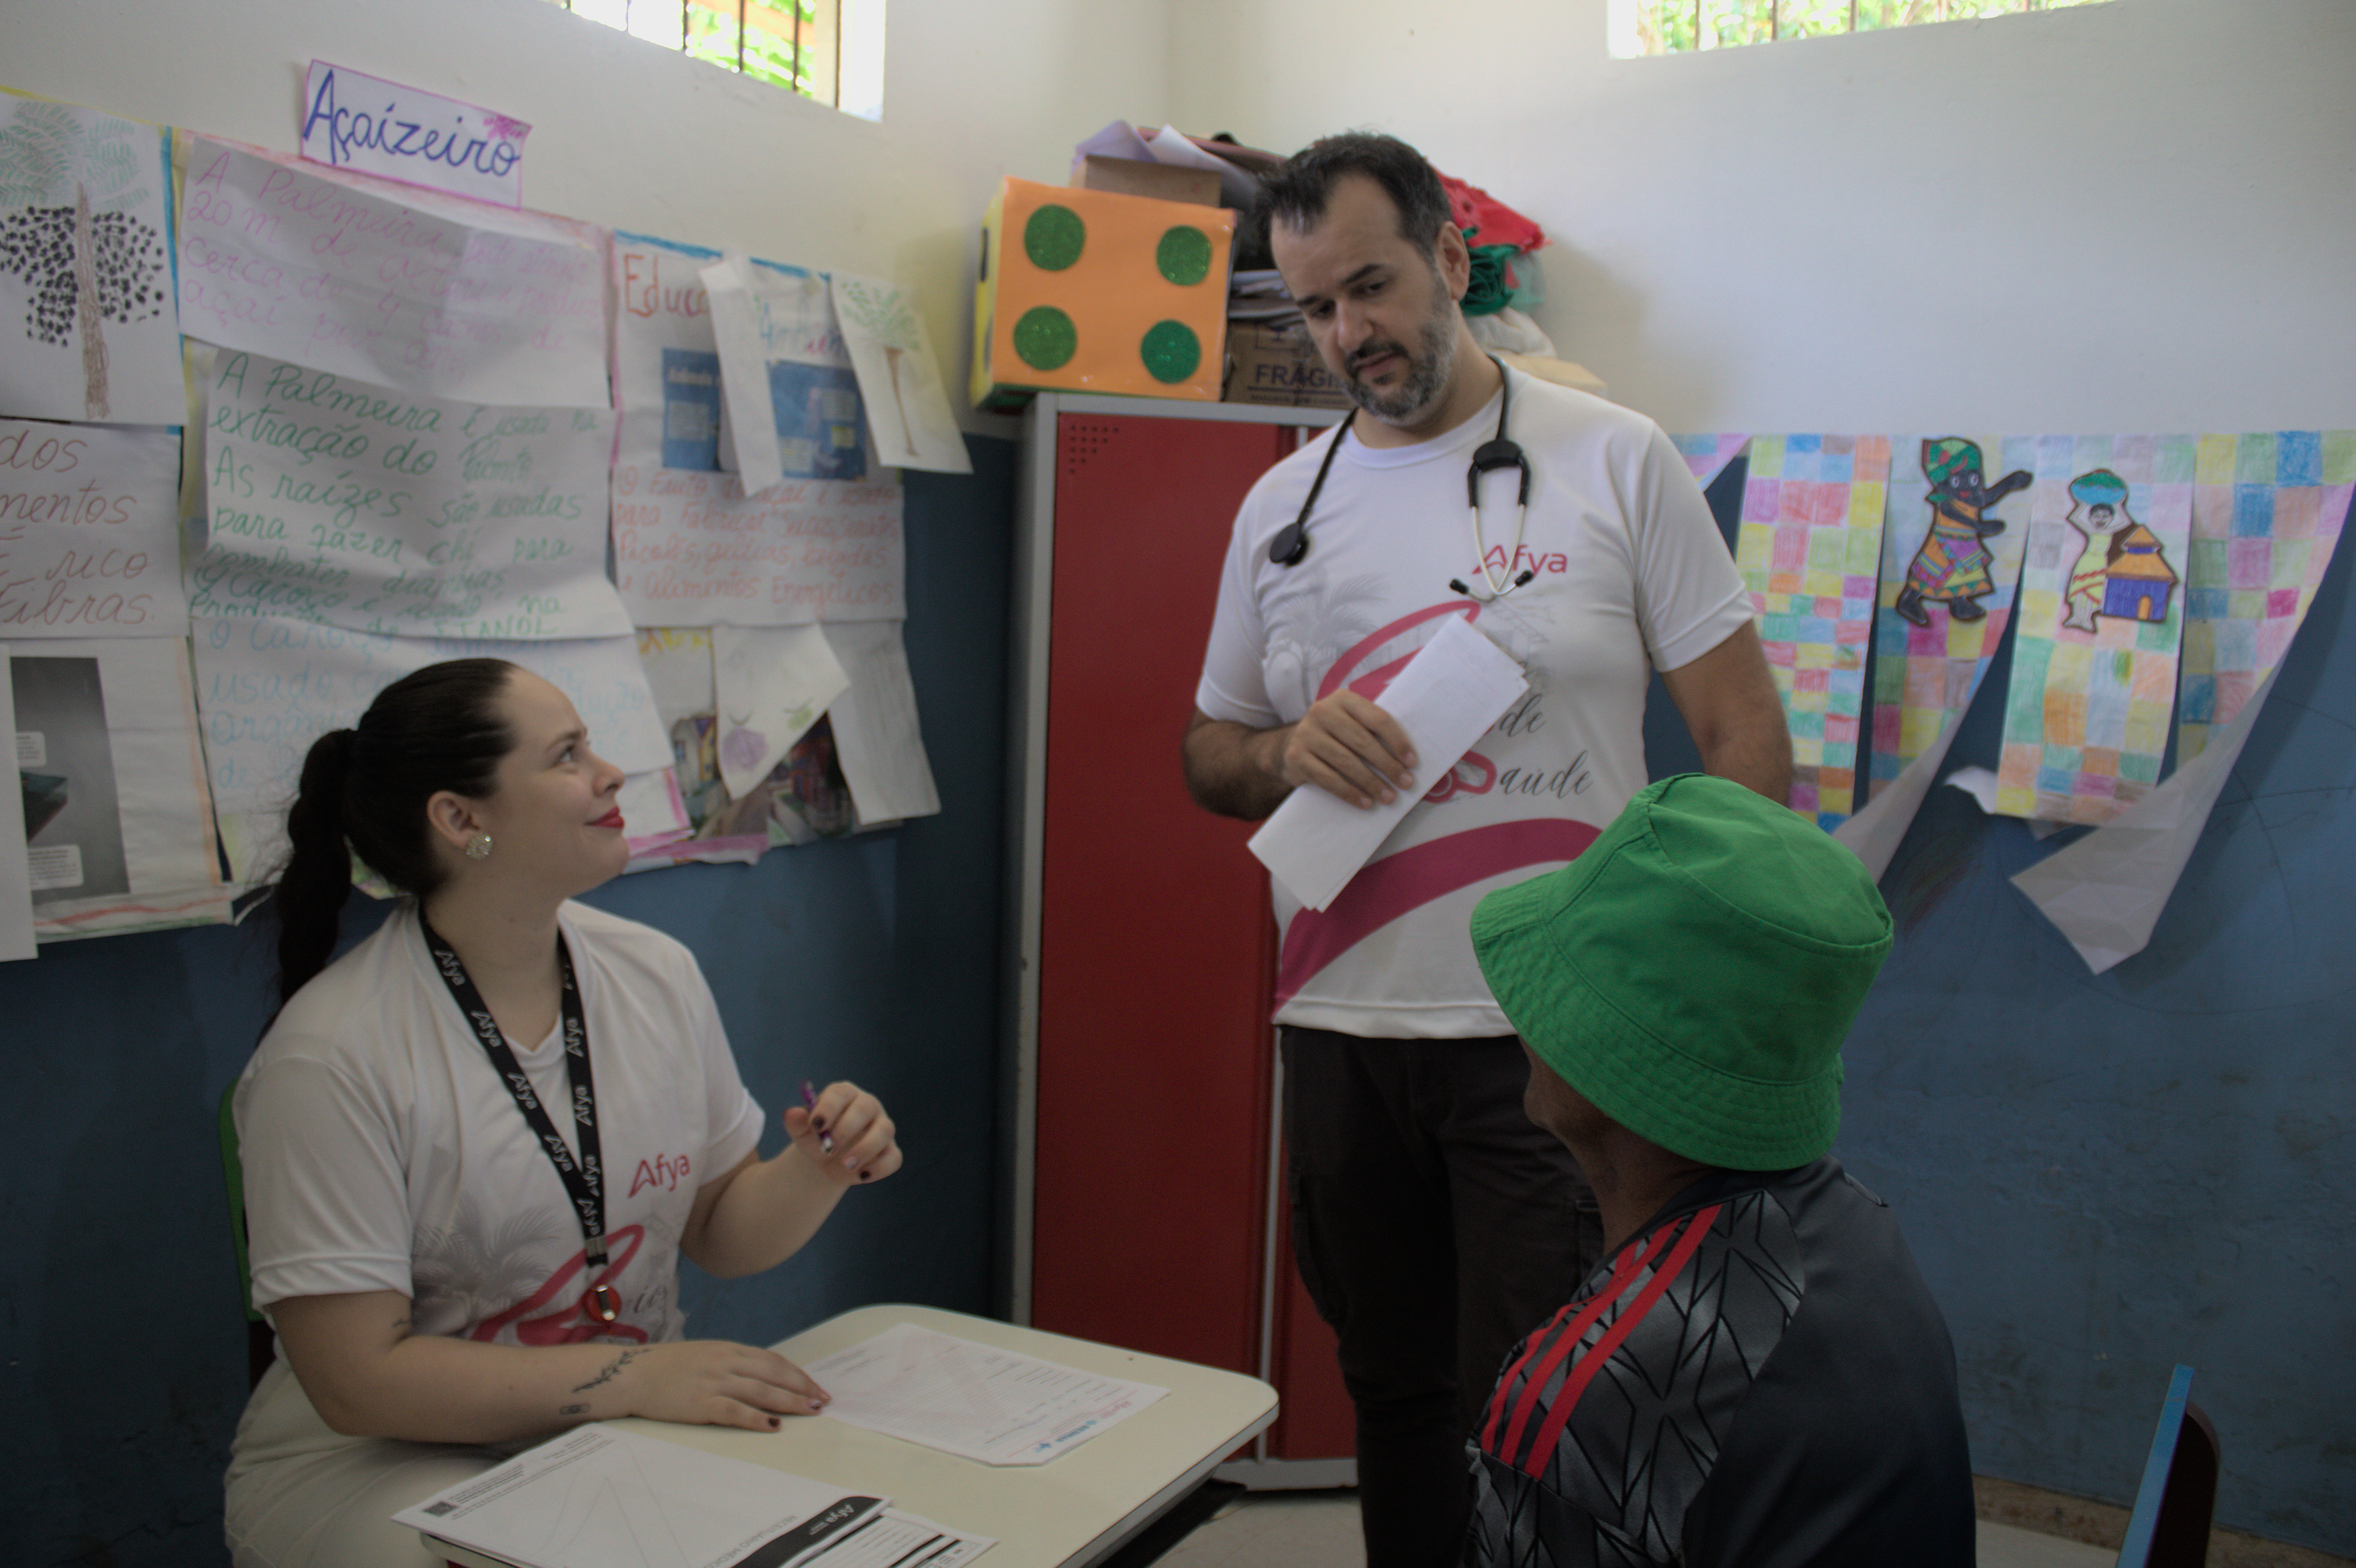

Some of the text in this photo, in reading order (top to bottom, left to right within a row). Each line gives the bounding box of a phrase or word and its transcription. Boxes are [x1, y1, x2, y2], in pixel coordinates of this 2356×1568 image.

[195, 150, 230, 195] A
[187, 190, 232, 226] 20
[242, 207, 280, 244] m
[311, 228, 357, 263] de
[300, 273, 343, 302] de
[377, 287, 402, 325] 4
[217, 353, 249, 399] A
[1255, 363, 1339, 388] FRAGI
[209, 403, 370, 465] extração
[382, 438, 438, 476] do
[270, 471, 414, 530] raízes
[211, 505, 289, 540] para
[1471, 544, 1567, 577] Afya
[434, 949, 465, 986] Afya
[471, 1010, 502, 1047] Afya
[565, 1017, 584, 1058] Afya
[507, 1072, 537, 1110] Afya
[574, 1085, 593, 1127] Afya
[545, 1135, 574, 1172] Afya
[628, 1153, 691, 1198] Afya
[825, 1503, 855, 1525] Afya
